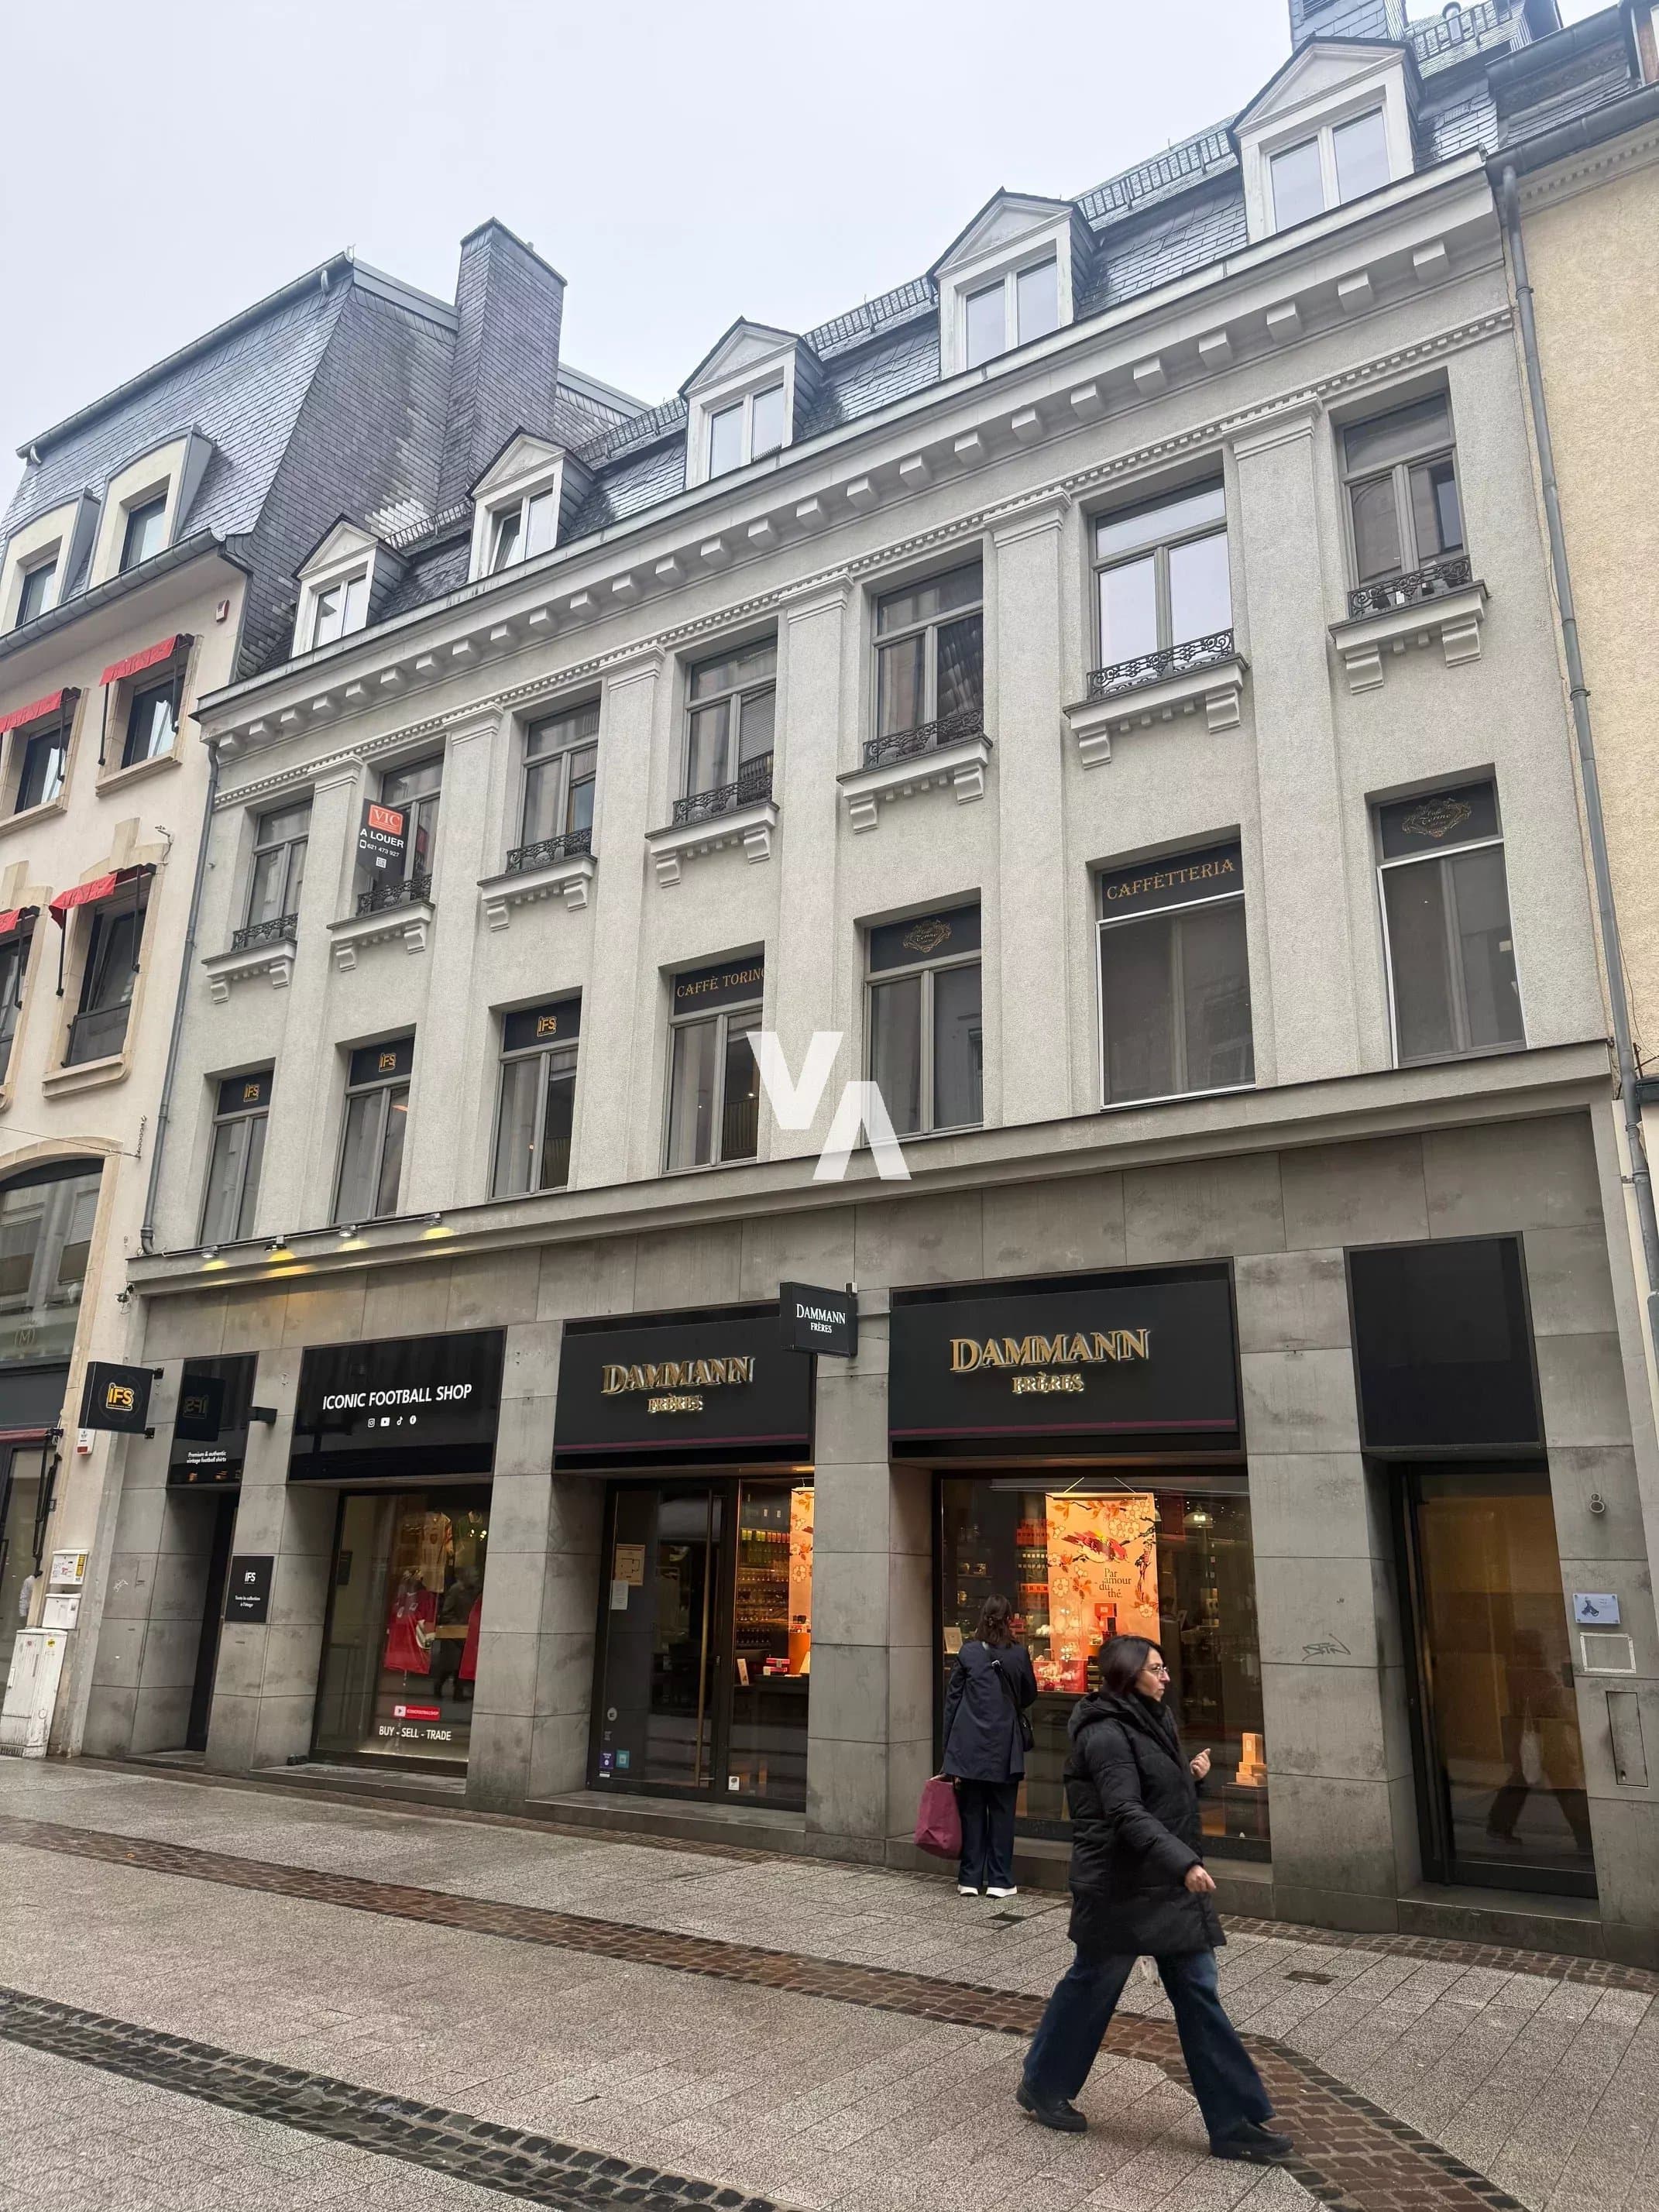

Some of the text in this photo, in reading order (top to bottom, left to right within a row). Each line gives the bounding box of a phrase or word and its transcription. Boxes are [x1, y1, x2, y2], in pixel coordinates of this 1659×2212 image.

[373, 809, 400, 826] VIC
[370, 831, 404, 848] LOUER
[1106, 858, 1236, 900] CAFFÈTTERIA
[676, 976, 719, 998] CAFFÈ
[796, 1304, 846, 1324] DAMMANN
[810, 1322, 832, 1333] FRÈRES
[950, 1328, 1151, 1372] DAMMANN
[601, 1356, 755, 1394] DAMMANN
[1012, 1372, 1085, 1394] FRÈRES
[322, 1383, 472, 1410] ICONIC FOOTBALL SHOP
[647, 1393, 703, 1413] FRÈRES
[1104, 1568, 1118, 1578] Par
[1099, 1580, 1111, 1591] du
[379, 1726, 394, 1736] BUY
[401, 1727, 419, 1738] SELL
[426, 1729, 452, 1741] TRADE
